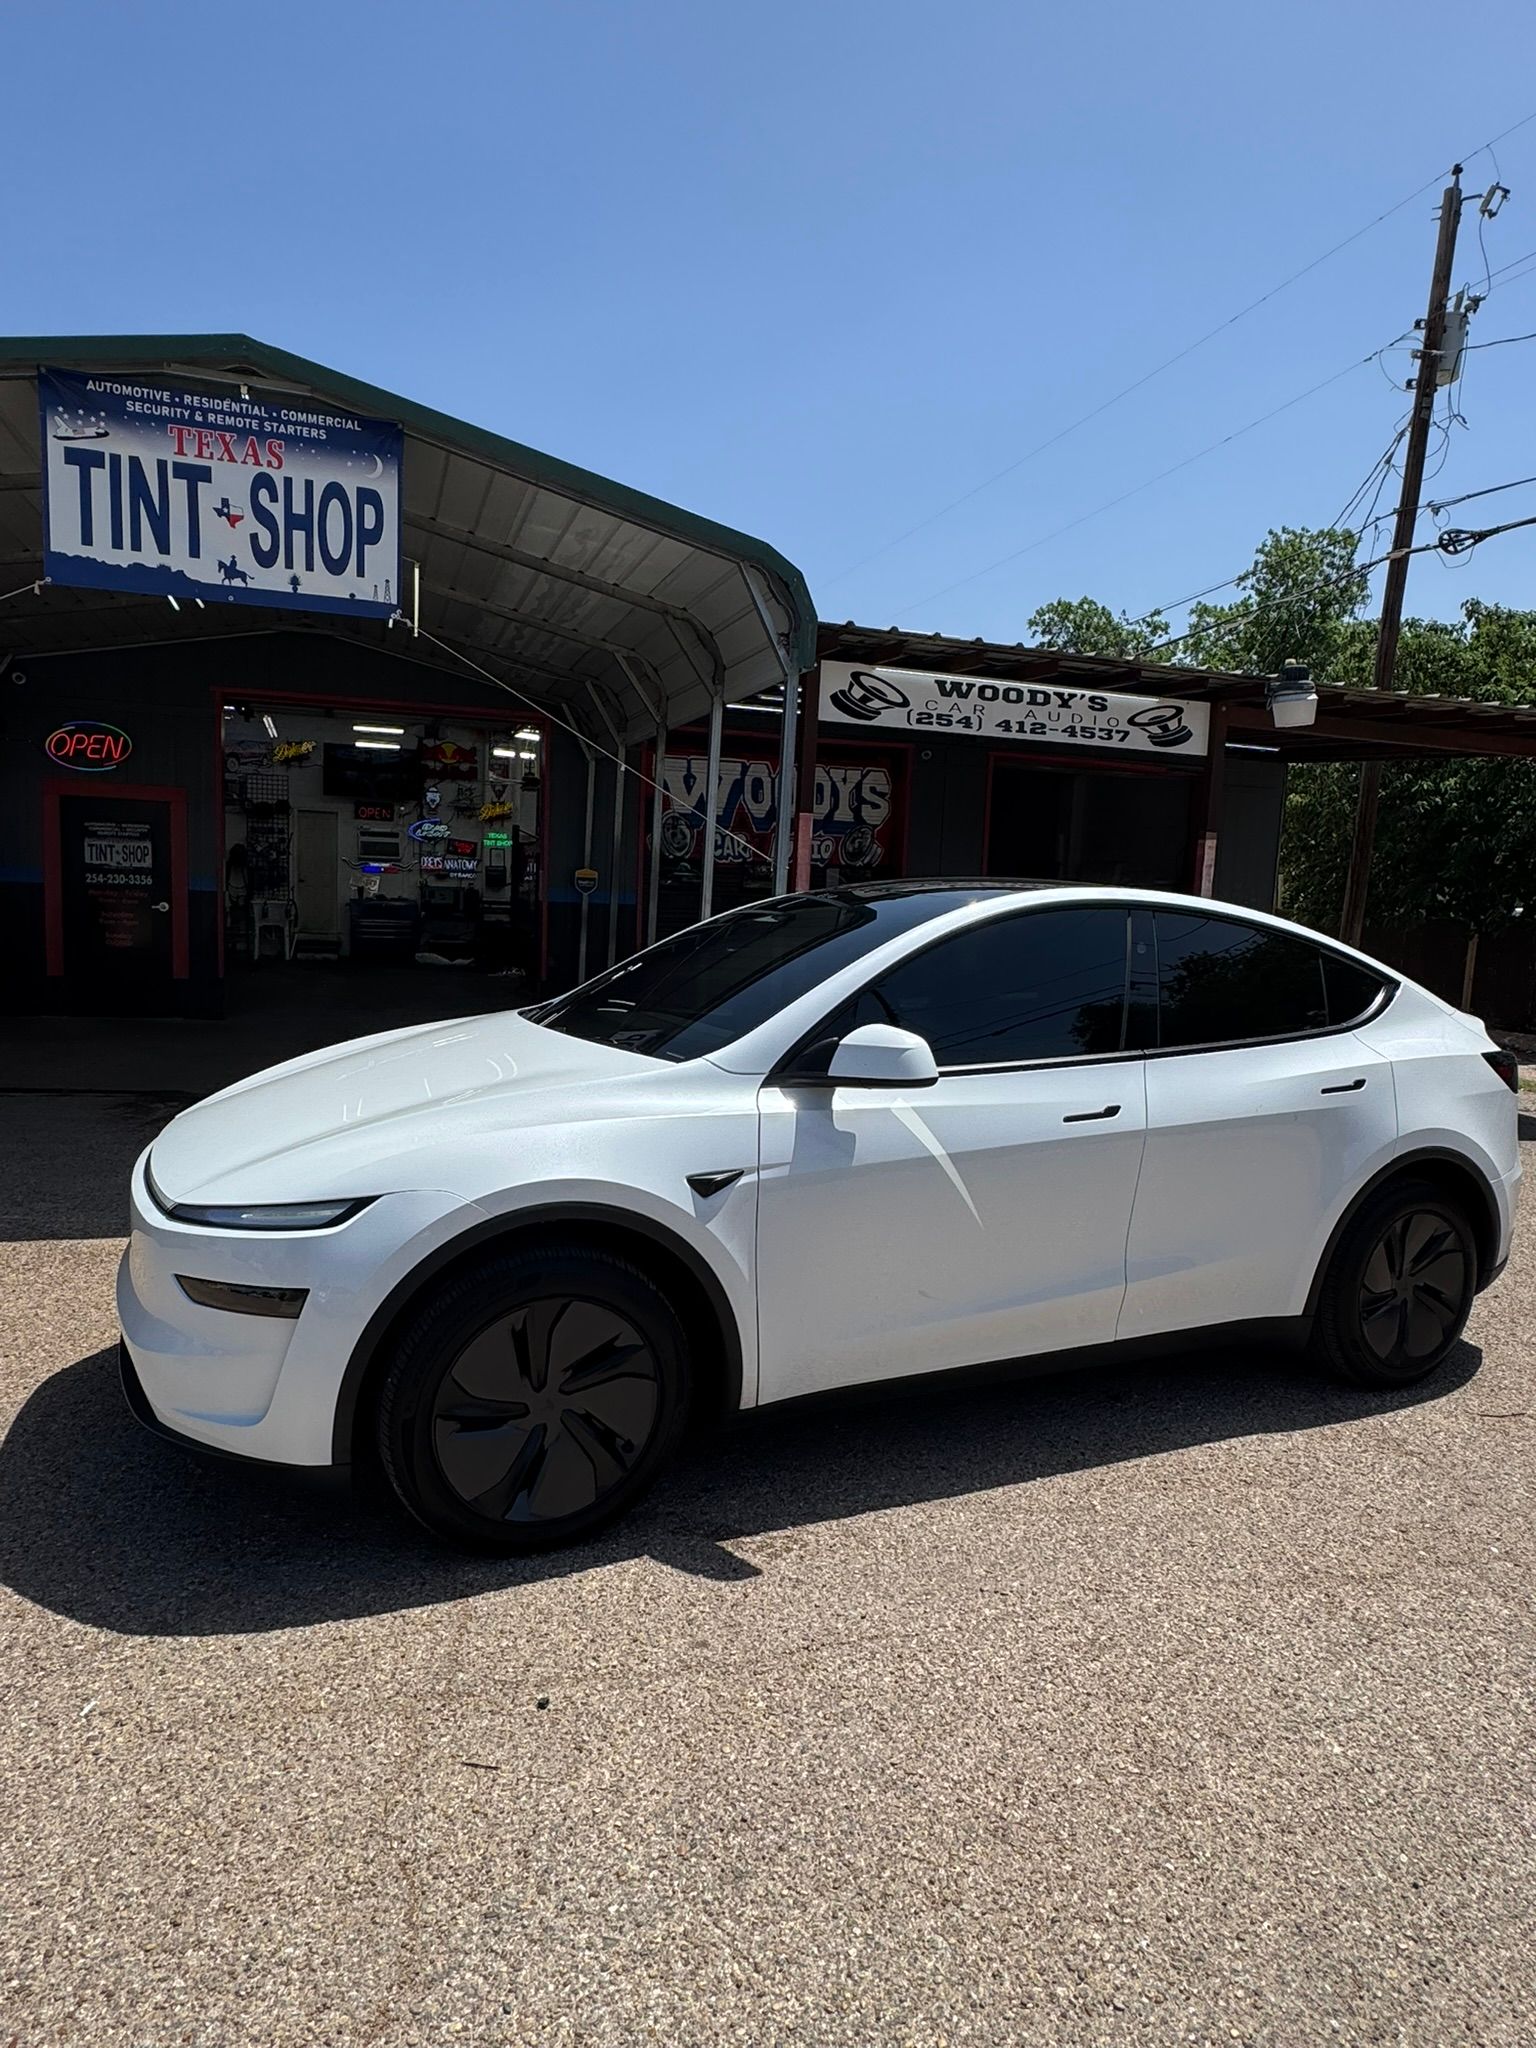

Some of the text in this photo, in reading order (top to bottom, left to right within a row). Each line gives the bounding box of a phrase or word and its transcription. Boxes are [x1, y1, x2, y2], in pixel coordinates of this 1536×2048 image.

[86, 379, 362, 431] AUTOMOTIVE RESIDENTIAL COMMERCIAL
[126, 400, 327, 440] SECURITY & REMOTE STARTERS
[168, 424, 285, 470] TEXAS
[64, 446, 384, 578] TINT SHOP
[934, 679, 1108, 712] WOODY'S
[906, 708, 1130, 743] (254) 412-4537
[925, 700, 1120, 728] CAR AUDIO
[51, 733, 124, 759] OPEN
[655, 755, 891, 827] WODYS
[358, 806, 391, 819] OPEN
[88, 844, 149, 863] TINT SHOP
[84, 872, 153, 886] 254-230-3356
